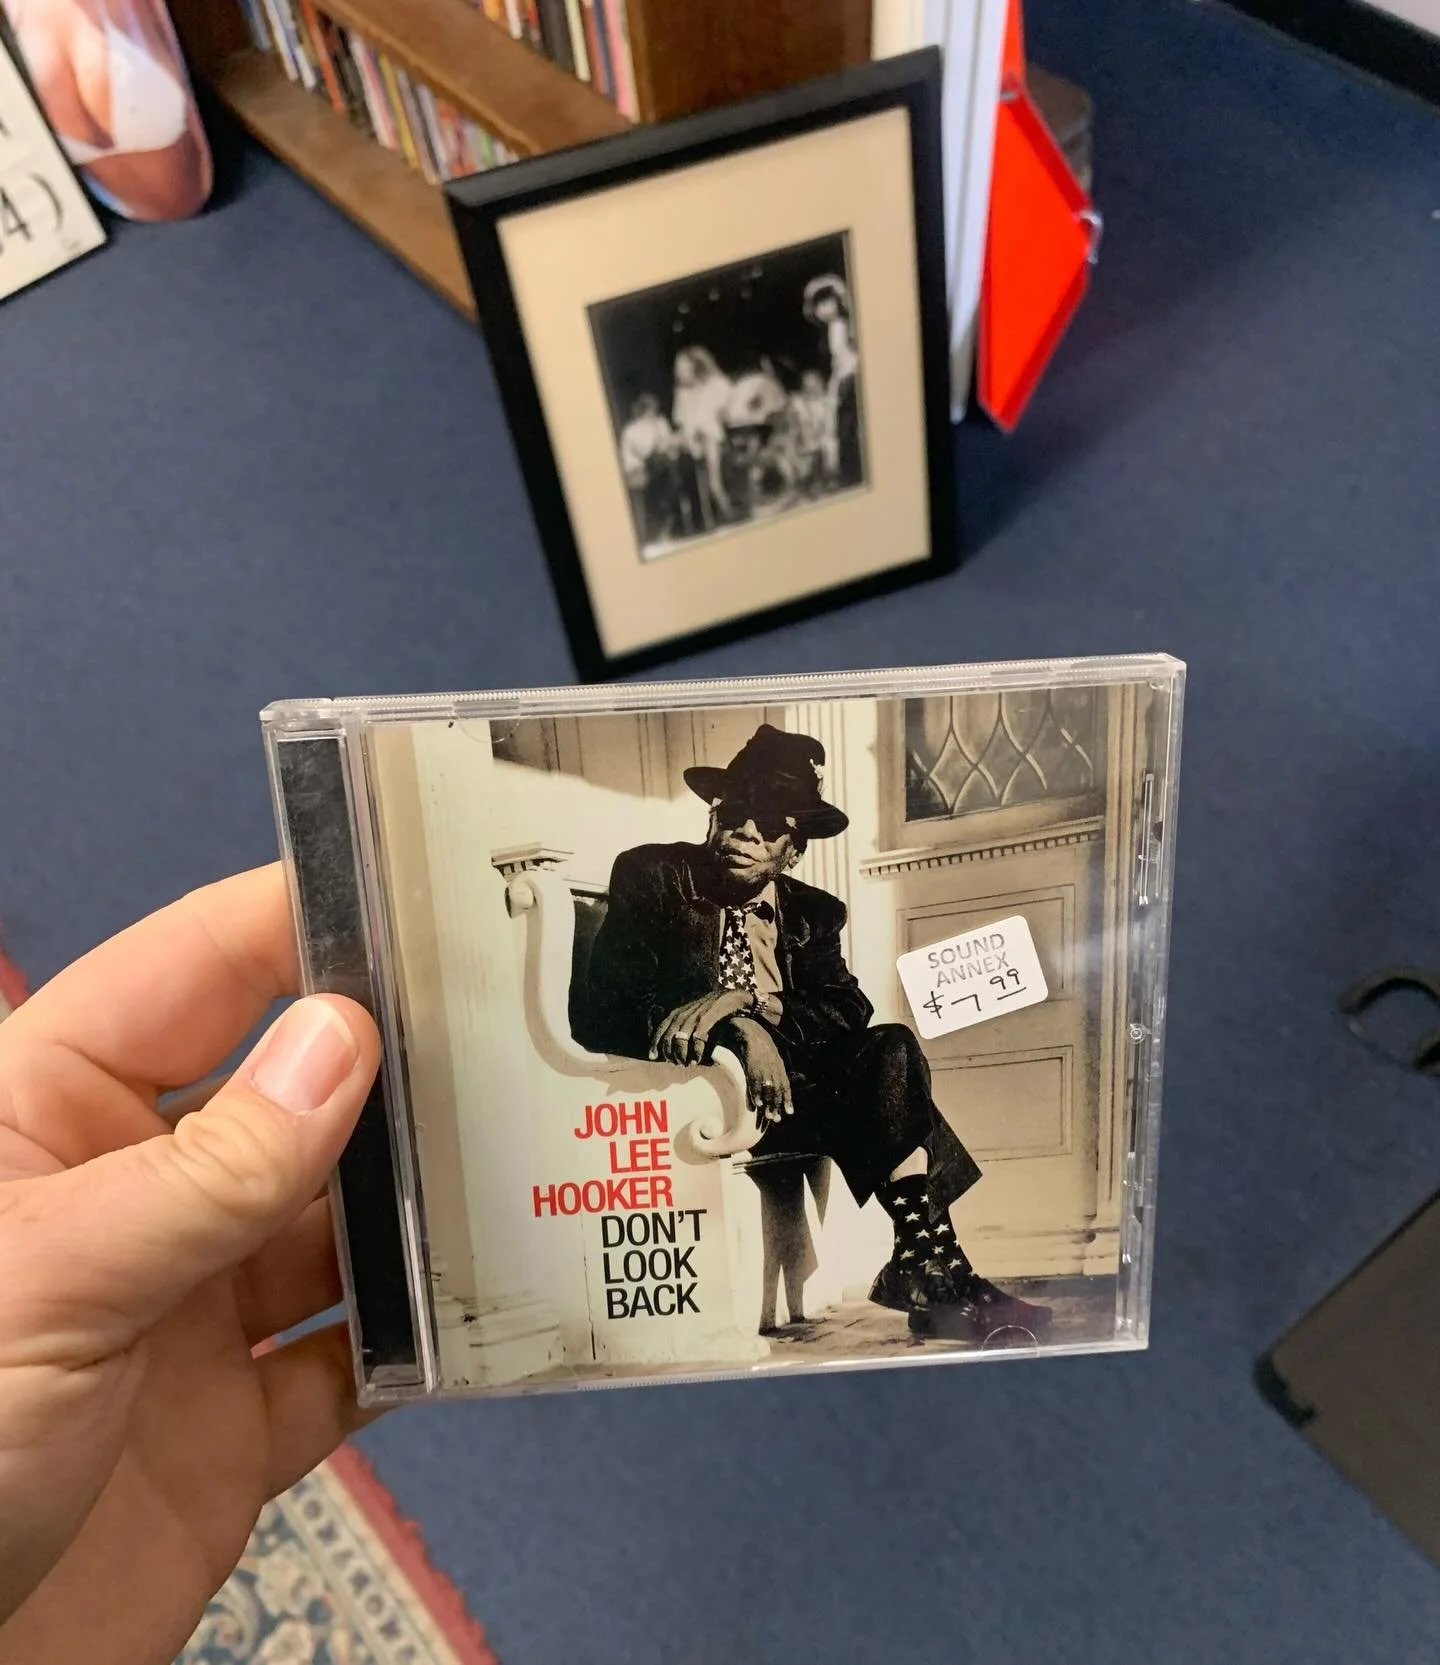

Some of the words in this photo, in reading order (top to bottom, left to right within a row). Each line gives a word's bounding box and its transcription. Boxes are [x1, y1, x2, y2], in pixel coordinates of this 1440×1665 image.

[927, 933, 1005, 969] SOUND
[936, 951, 1010, 988] ANNEX
[574, 1100, 668, 1139] JOHN
[609, 1138, 672, 1174] LEE
[532, 1175, 674, 1217] HOOKER
[601, 1209, 707, 1248] DON'T
[602, 1246, 698, 1284] LOOK
[606, 1282, 700, 1320] BACK
